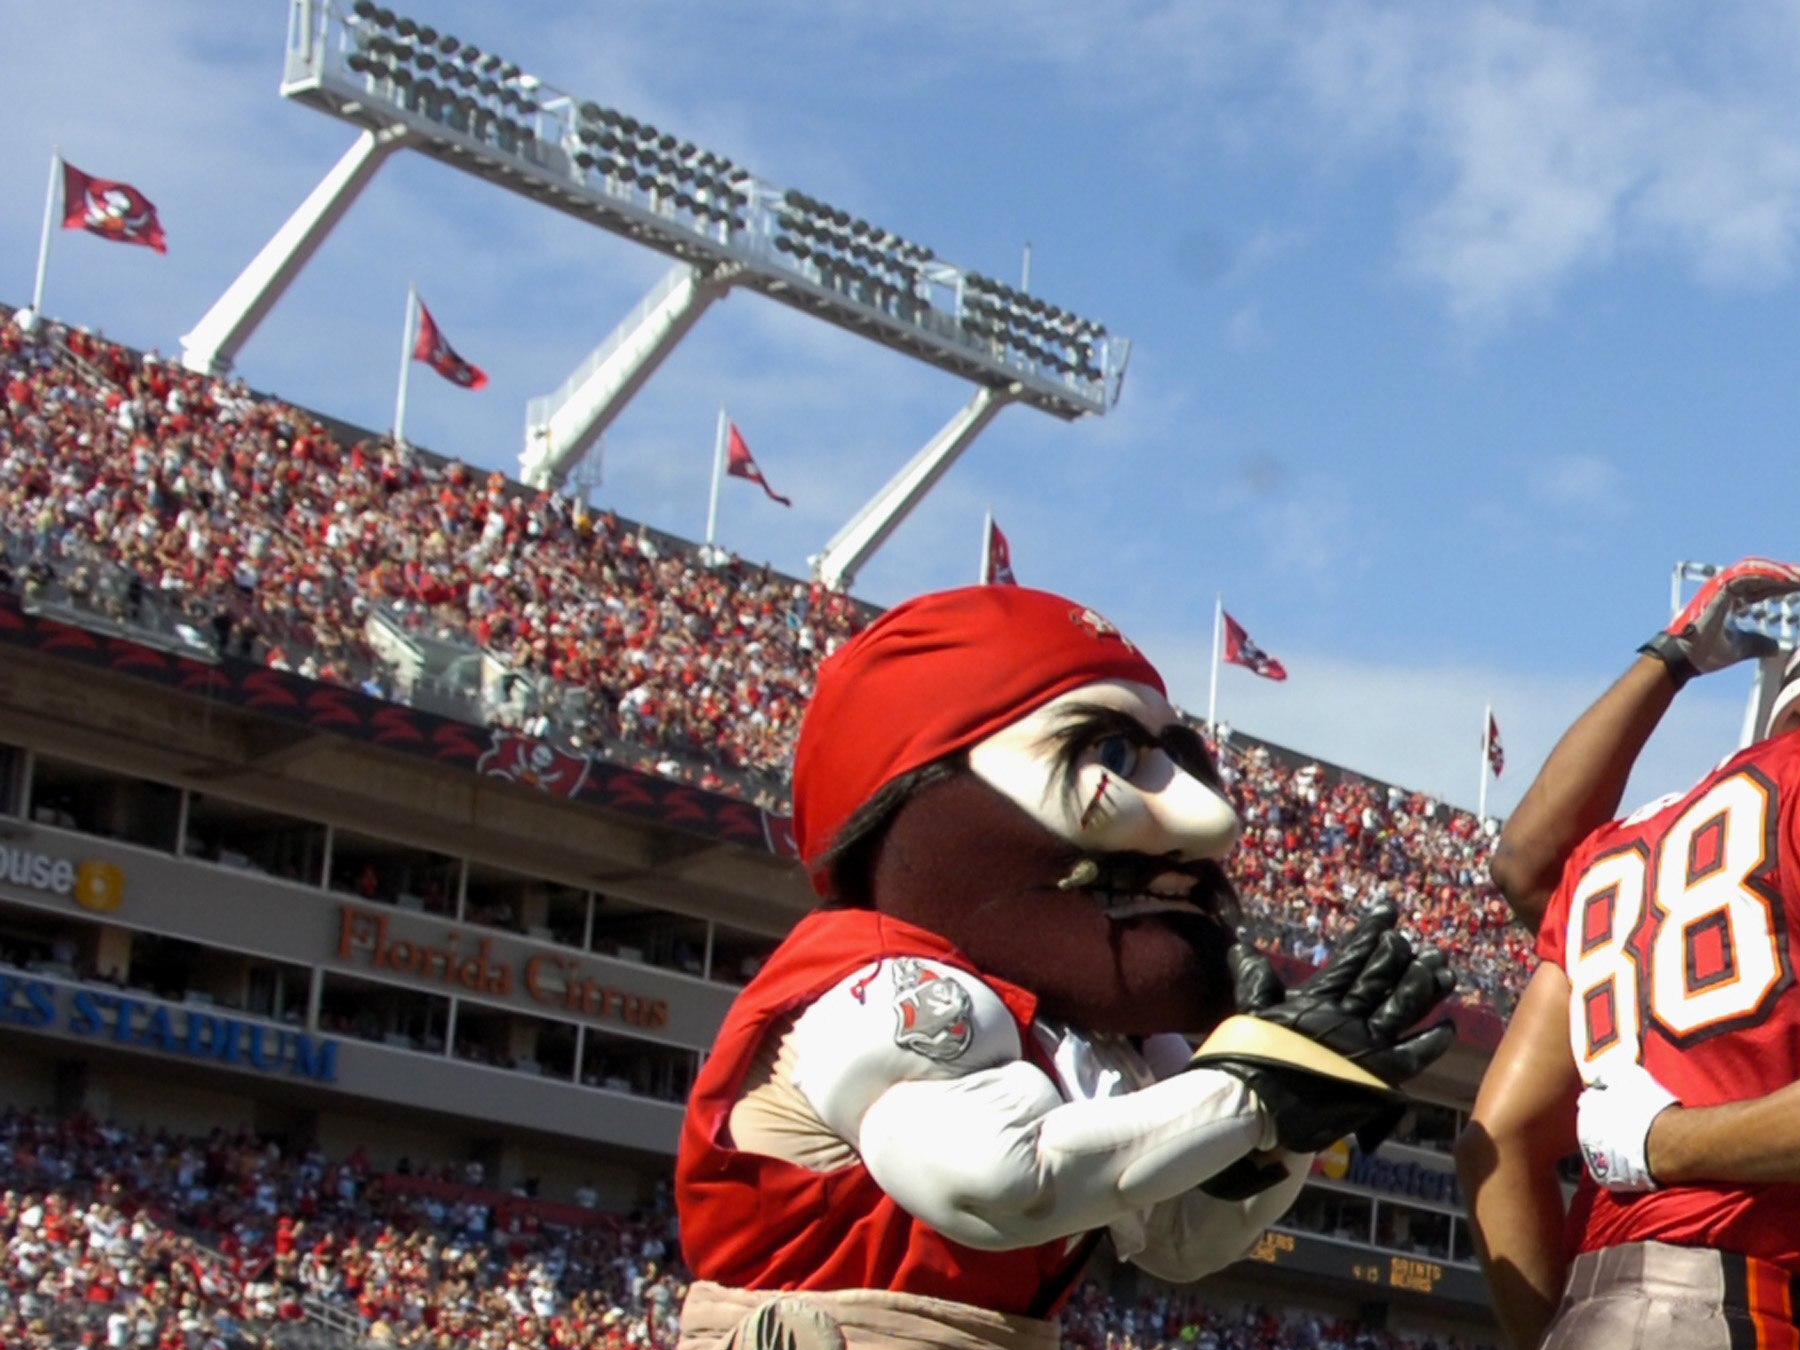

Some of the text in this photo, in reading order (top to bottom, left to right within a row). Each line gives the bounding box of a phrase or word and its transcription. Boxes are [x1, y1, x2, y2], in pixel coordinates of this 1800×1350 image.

[338, 903, 669, 1029] Florida Citrus
[1562, 762, 1796, 1095] 88
[67, 987, 338, 1083] STADIUM
